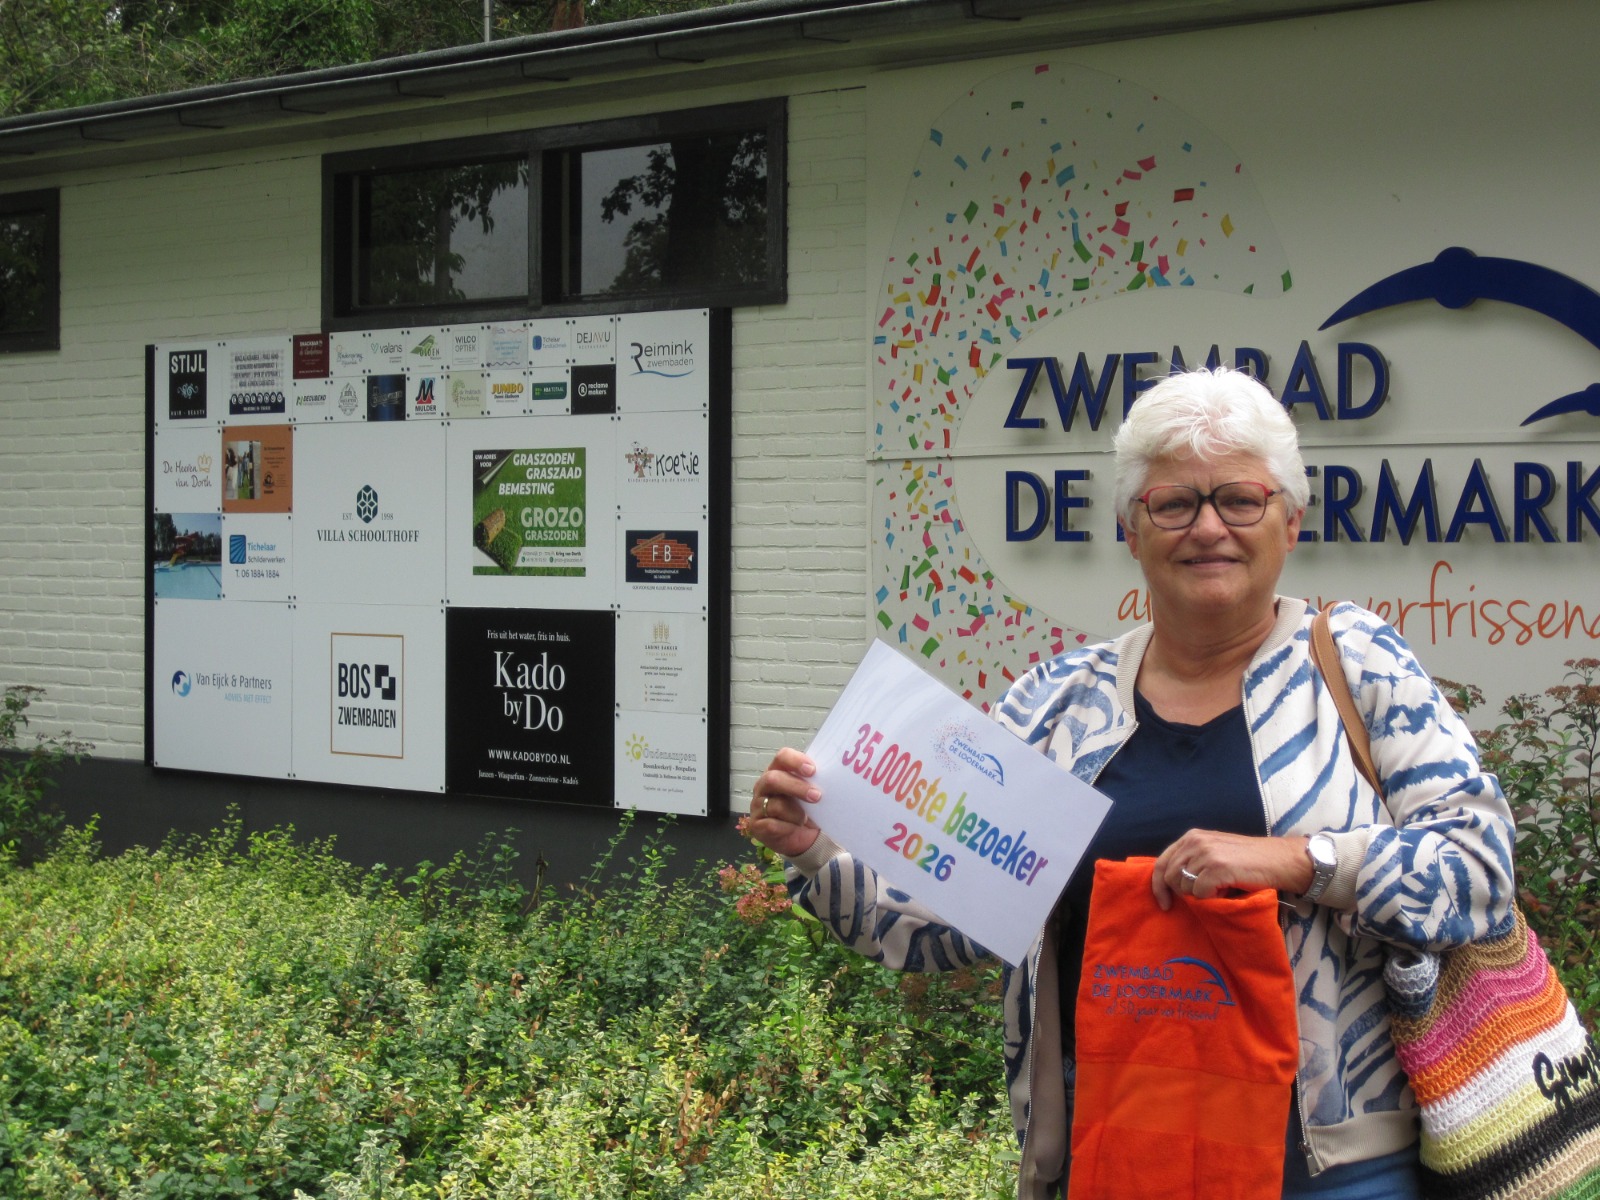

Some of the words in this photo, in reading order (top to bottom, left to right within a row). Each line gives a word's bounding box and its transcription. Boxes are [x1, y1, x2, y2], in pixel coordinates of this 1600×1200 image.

[455, 335, 477, 344] WILCO
[455, 344, 477, 353] OPTIEK
[630, 340, 693, 372] Reimink
[171, 354, 206, 374] STIJL
[647, 358, 694, 368] zwembaden
[491, 383, 524, 395] JUMBO
[588, 388, 607, 396] makers
[513, 452, 576, 466] GRASZODEN
[655, 451, 700, 477] Koetje
[163, 461, 173, 474] De
[526, 466, 583, 480] GRASZAAD
[175, 478, 189, 488] van
[191, 475, 212, 488] Dorth
[498, 482, 555, 496] BEMESTING
[1005, 469, 1092, 543] DE
[1116, 458, 1600, 546] RMARK
[521, 506, 584, 528] GROZO
[317, 529, 346, 542] VILLA
[348, 529, 420, 543] SCHOOLTHOFF
[525, 530, 579, 541] GRASZODEN
[248, 542, 276, 551] Tichelaar
[652, 544, 659, 562] F
[664, 544, 672, 562] B
[248, 555, 286, 563] Schilderwerken
[242, 569, 250, 578] 06
[251, 569, 265, 578] 1884
[266, 569, 280, 578] 1884
[487, 629, 499, 639] Fris
[500, 630, 508, 640] uit
[509, 629, 518, 640] het
[519, 632, 537, 641] water,
[537, 630, 548, 641] fris
[549, 631, 555, 641] in
[556, 631, 571, 642] huis.
[493, 651, 566, 691] Kado
[196, 672, 210, 686] Van
[212, 673, 229, 690] Eijck
[231, 674, 237, 688] &
[239, 675, 272, 690] Partners
[338, 663, 371, 699] BOS
[338, 706, 396, 729] ZWEMBADEN
[503, 692, 523, 725] by
[523, 693, 564, 732] Do
[488, 749, 571, 765] WWW.KADOBYDO.NL
[953, 737, 985, 762] ZWEMBAD
[949, 745, 959, 754] DE
[958, 751, 998, 780] LOOERMARK
[841, 723, 948, 824] 35.000ste
[942, 792, 1049, 887] bezoeker
[884, 822, 956, 882] 2026
[1094, 963, 1174, 980] ZWEMBAD
[1092, 984, 1111, 997] DE
[1117, 984, 1213, 1003] LOOERMARK
